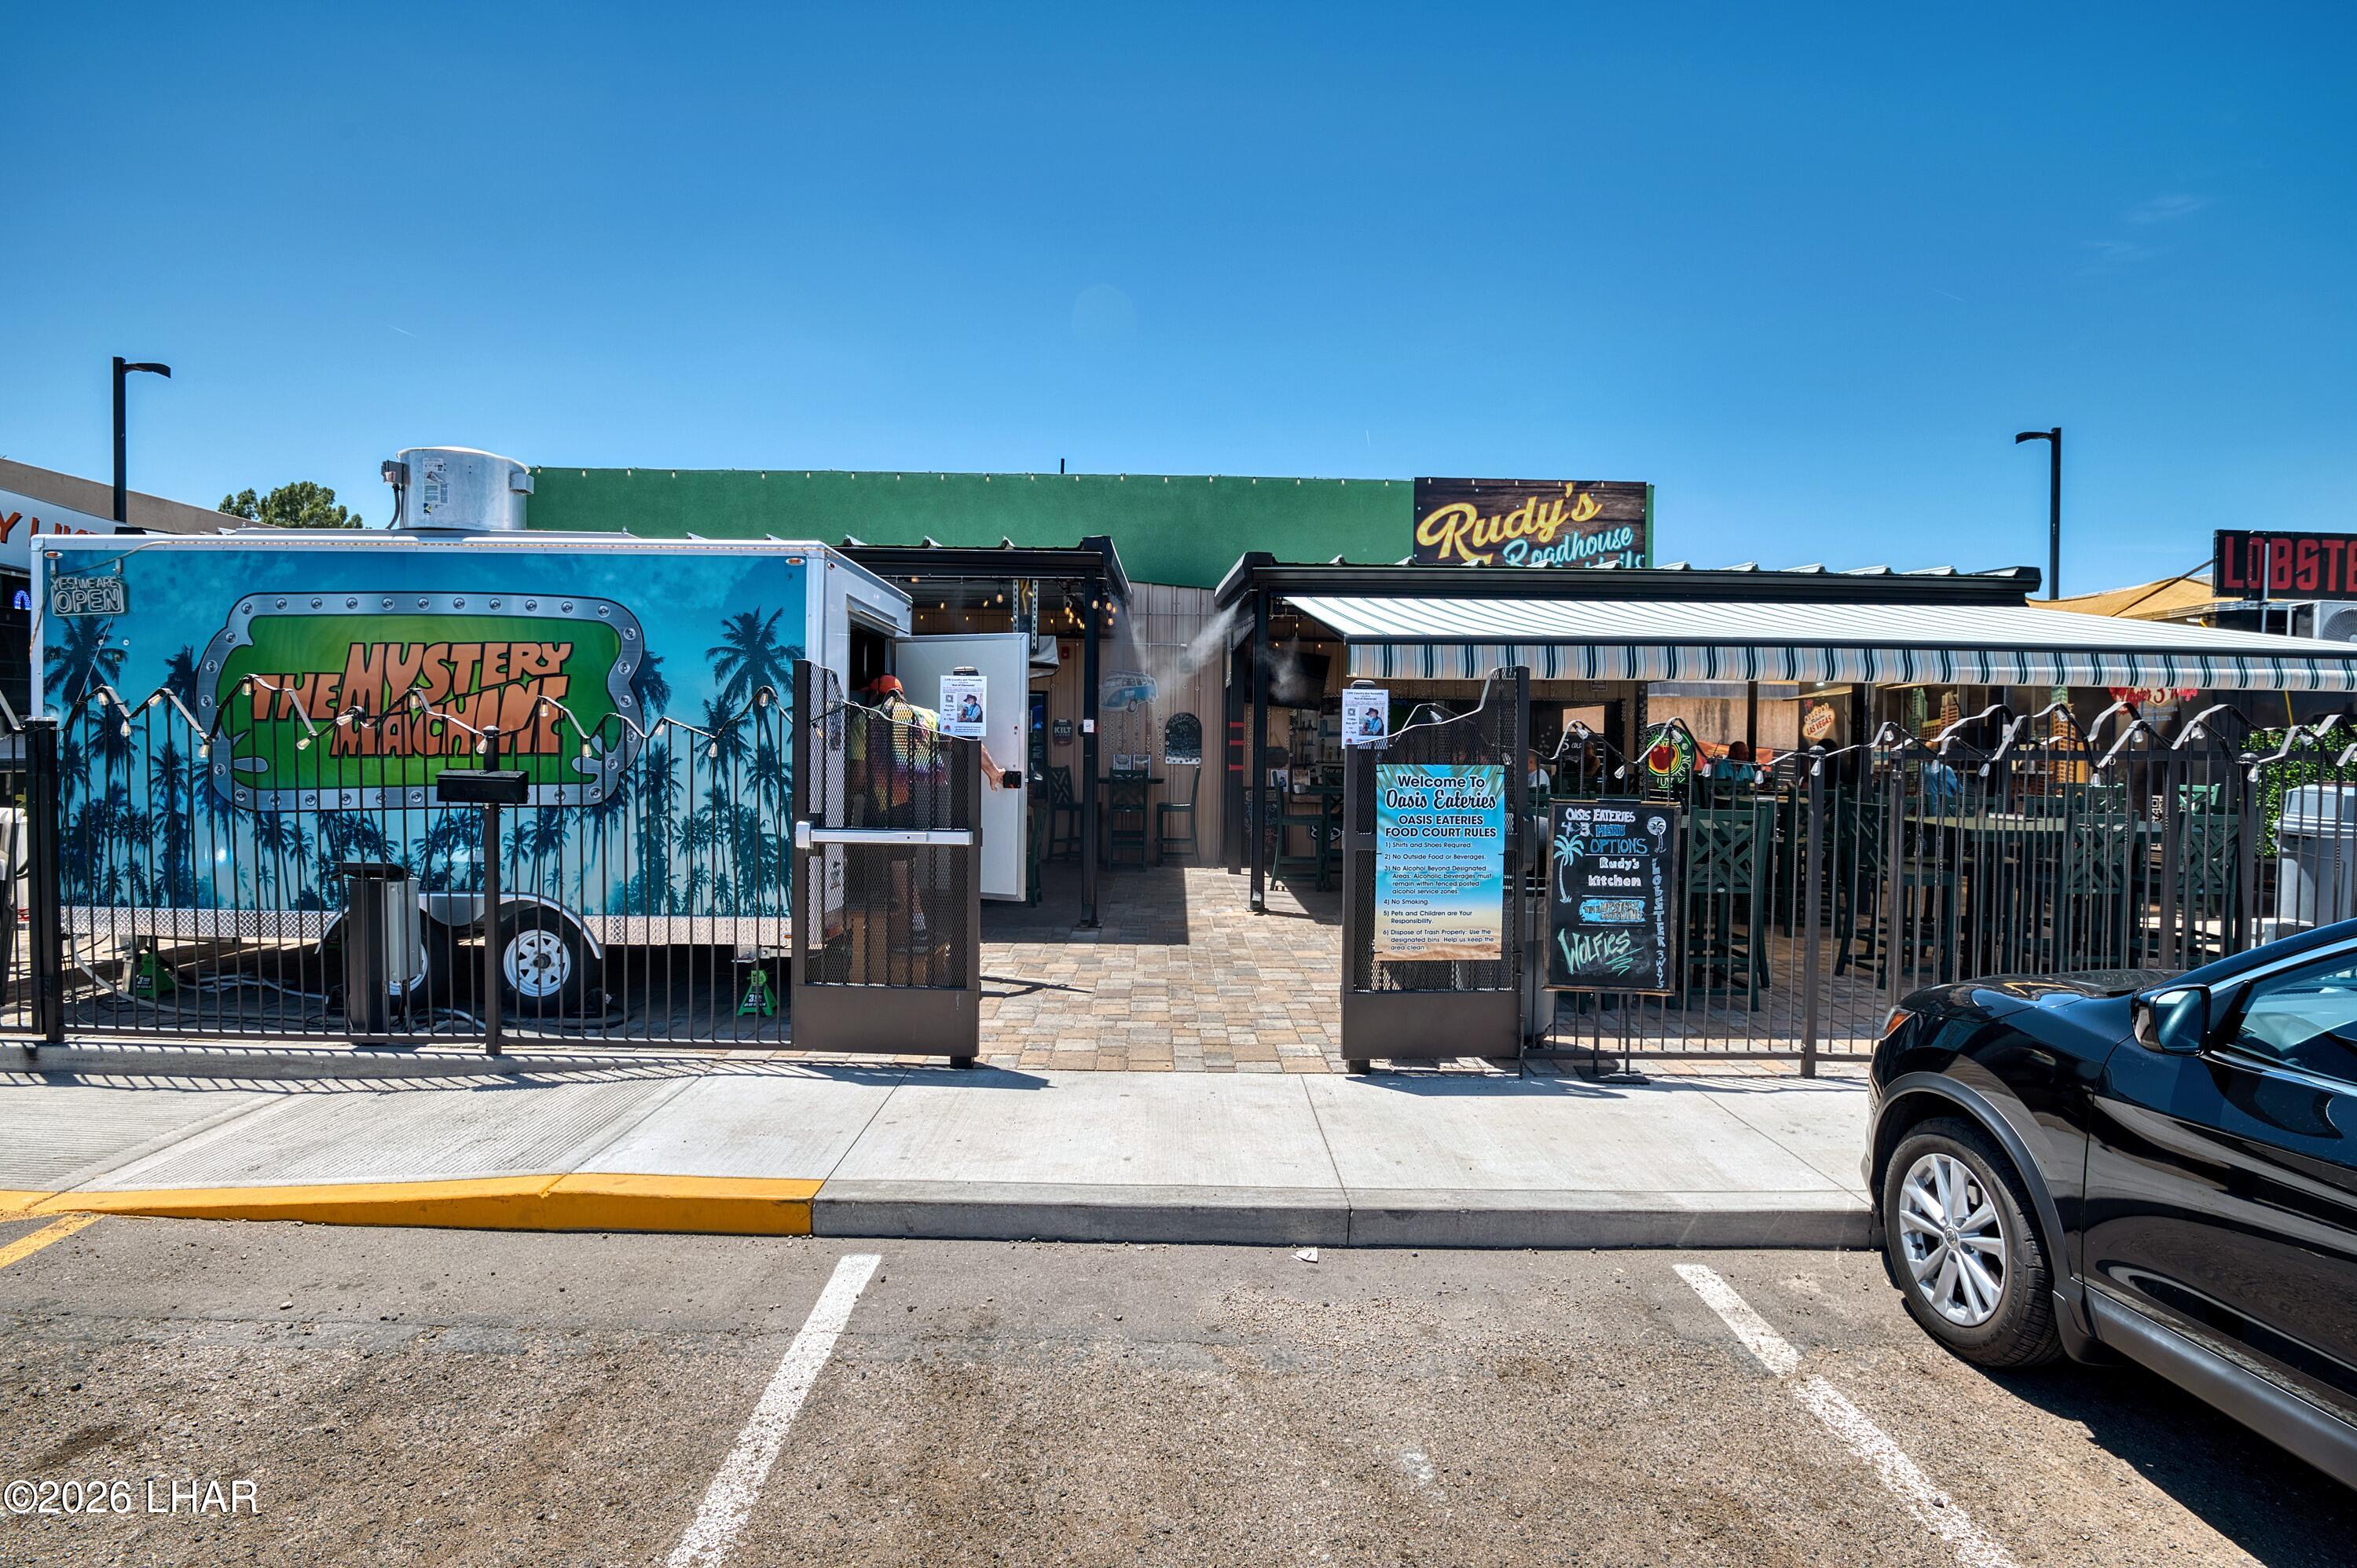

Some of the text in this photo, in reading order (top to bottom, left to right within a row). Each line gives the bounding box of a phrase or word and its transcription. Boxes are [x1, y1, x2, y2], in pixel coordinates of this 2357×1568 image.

[1417, 482, 1603, 564] Rudy's
[1502, 527, 1633, 566] Roadhouse
[79, 577, 95, 589] WE
[96, 577, 117, 588] ARE
[55, 588, 120, 613] OPEN
[338, 643, 573, 718] MYSTERY
[252, 672, 343, 720] THE
[329, 674, 570, 758] MACHINE
[1398, 775, 1485, 788] Welcome To
[1386, 789, 1497, 810] Oasis Eateries
[1398, 815, 1483, 825] OASIS EATERIES
[1565, 808, 1636, 822] OASIS EATERIES
[1386, 827, 1496, 837] FOOD COURT RULES
[1595, 824, 1626, 837] MENU
[1589, 837, 1648, 855] OPTIONS
[1599, 856, 1640, 871] Rudy's
[1588, 874, 1642, 887] Kitchen
[1583, 905, 1600, 914] THE
[1601, 901, 1639, 913] MYSTERY
[1651, 858, 1666, 947] LOBSTER
[1601, 907, 1642, 921] MACHINE
